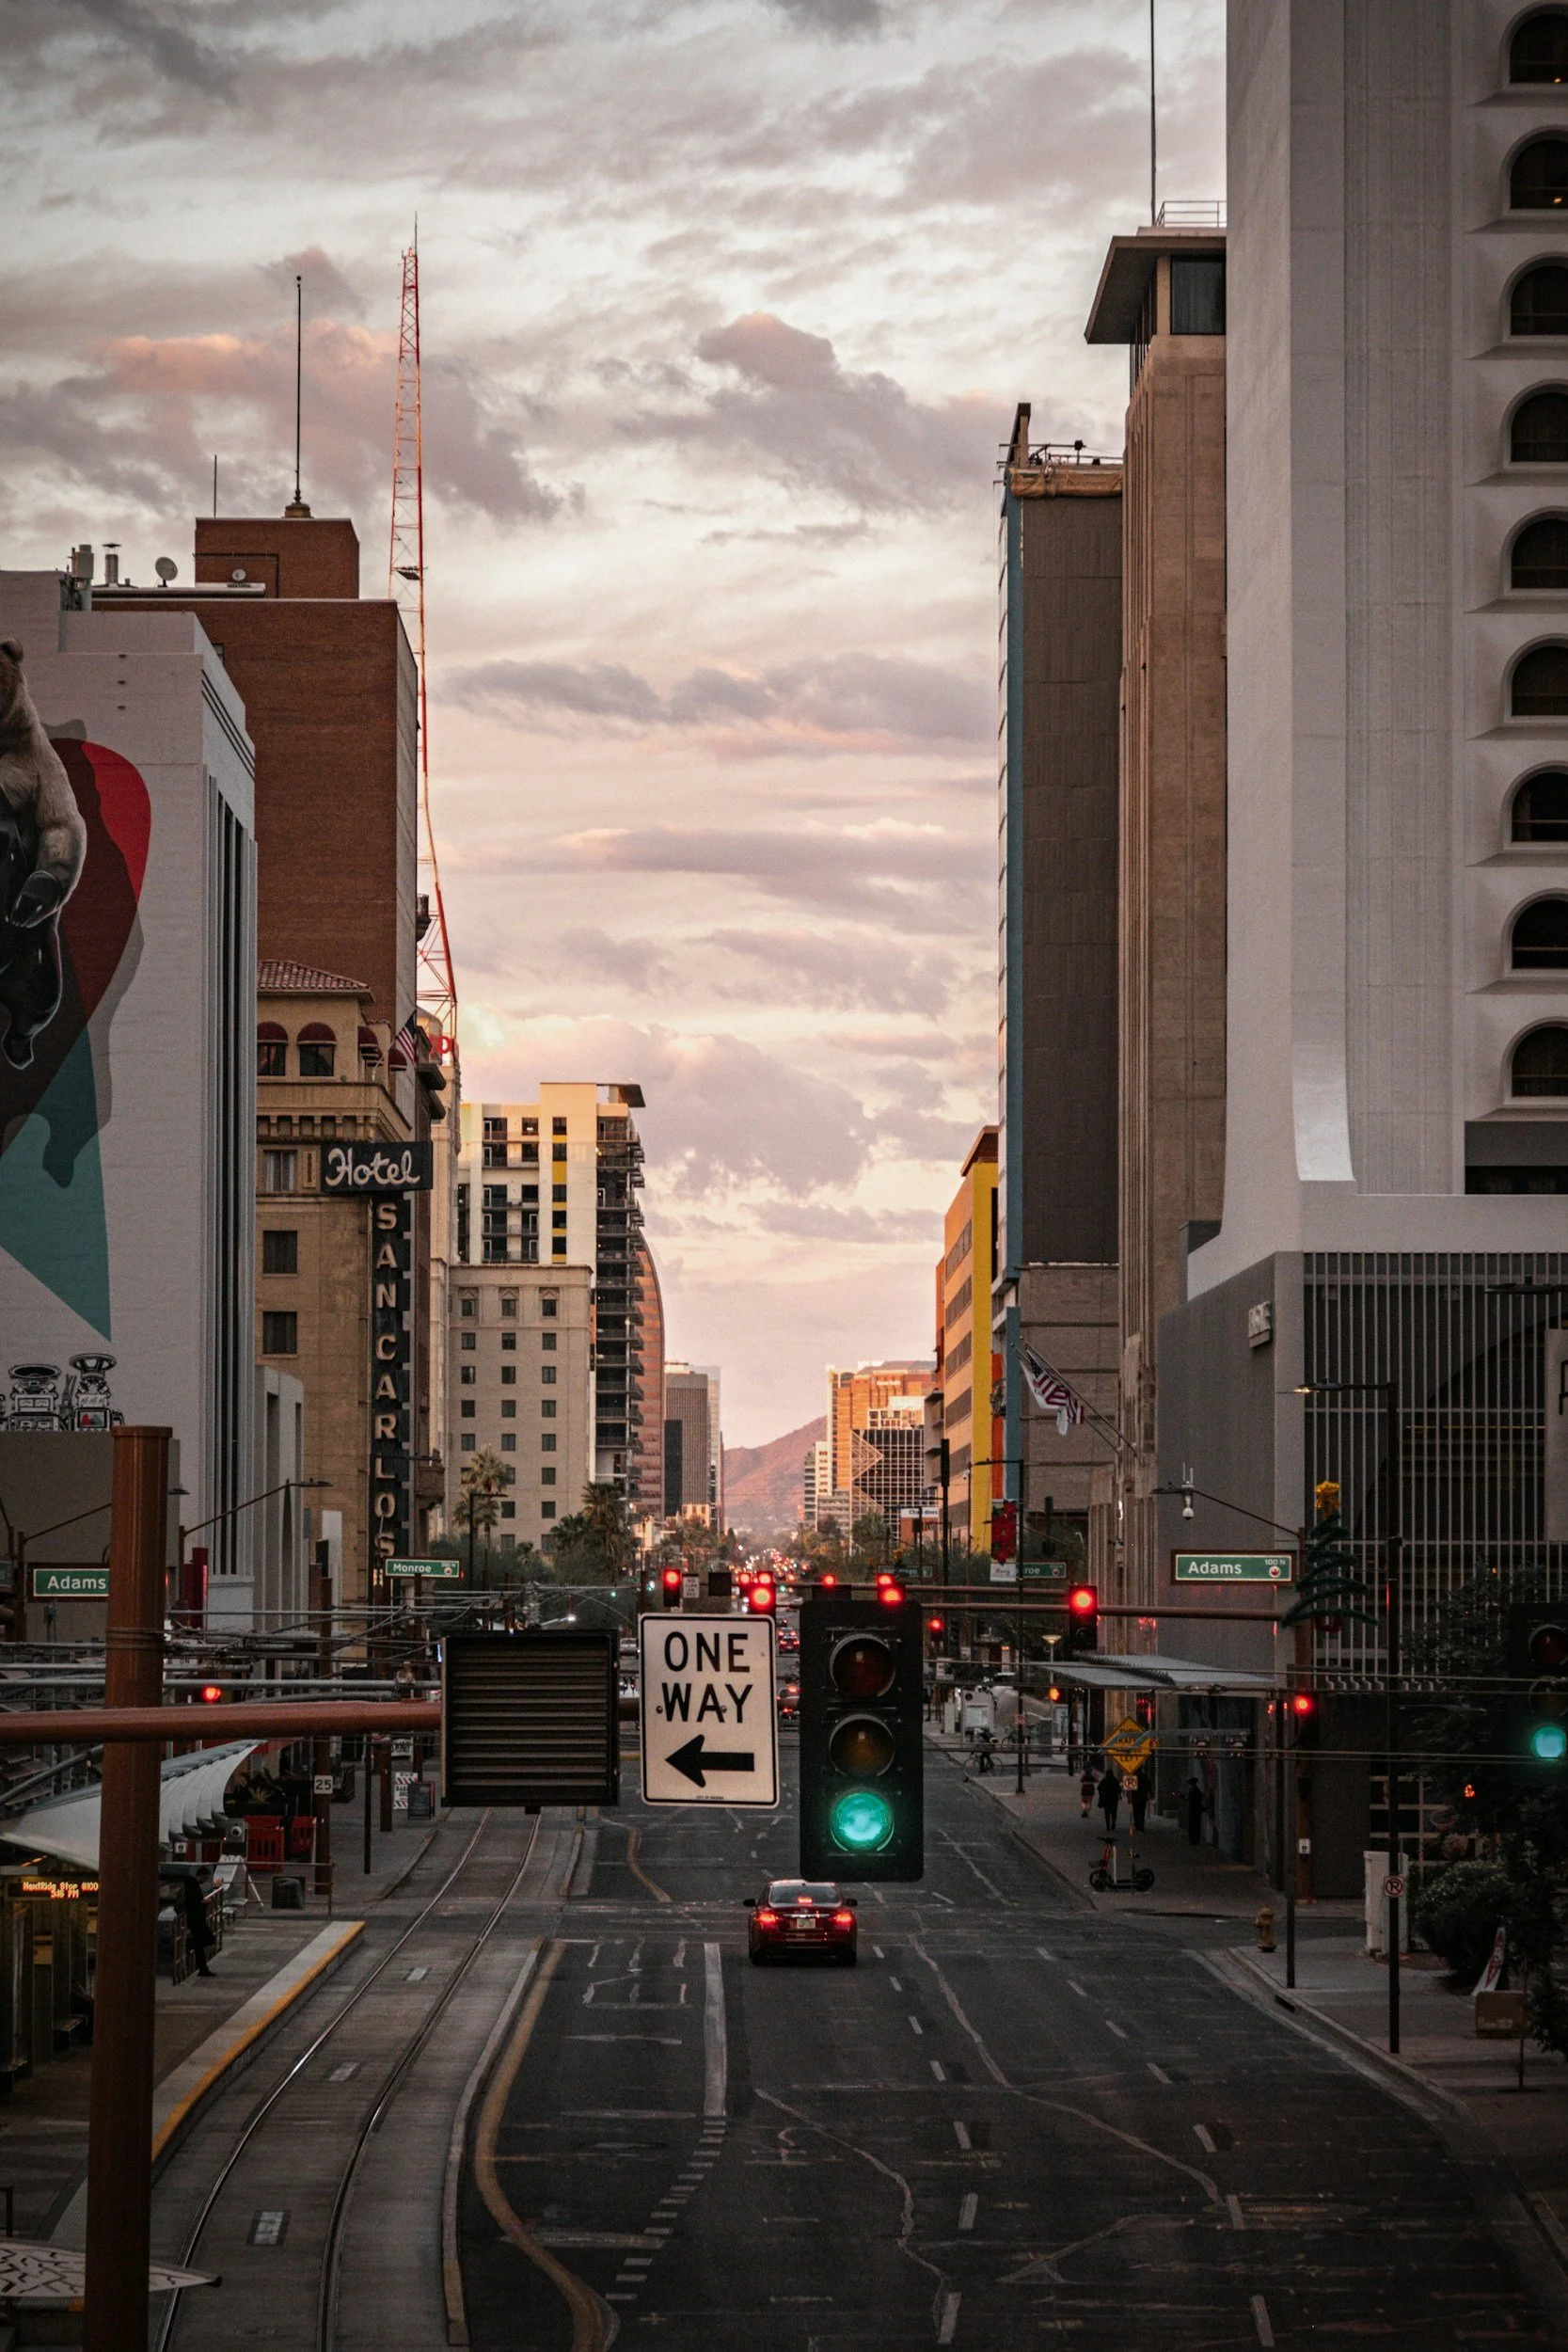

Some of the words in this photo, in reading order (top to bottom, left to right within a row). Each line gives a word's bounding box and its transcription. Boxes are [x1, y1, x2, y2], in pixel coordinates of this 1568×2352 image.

[325, 1146, 420, 1189] Hotel
[374, 1201, 398, 1310] SAN
[373, 1334, 398, 1557] CARLOS
[47, 1575, 107, 1590] Adams
[393, 1563, 433, 1573] Monroe
[1187, 1561, 1243, 1575] Adams
[664, 1631, 751, 1673] ONE
[662, 1683, 753, 1724] WAY
[315, 1779, 332, 1790] 25
